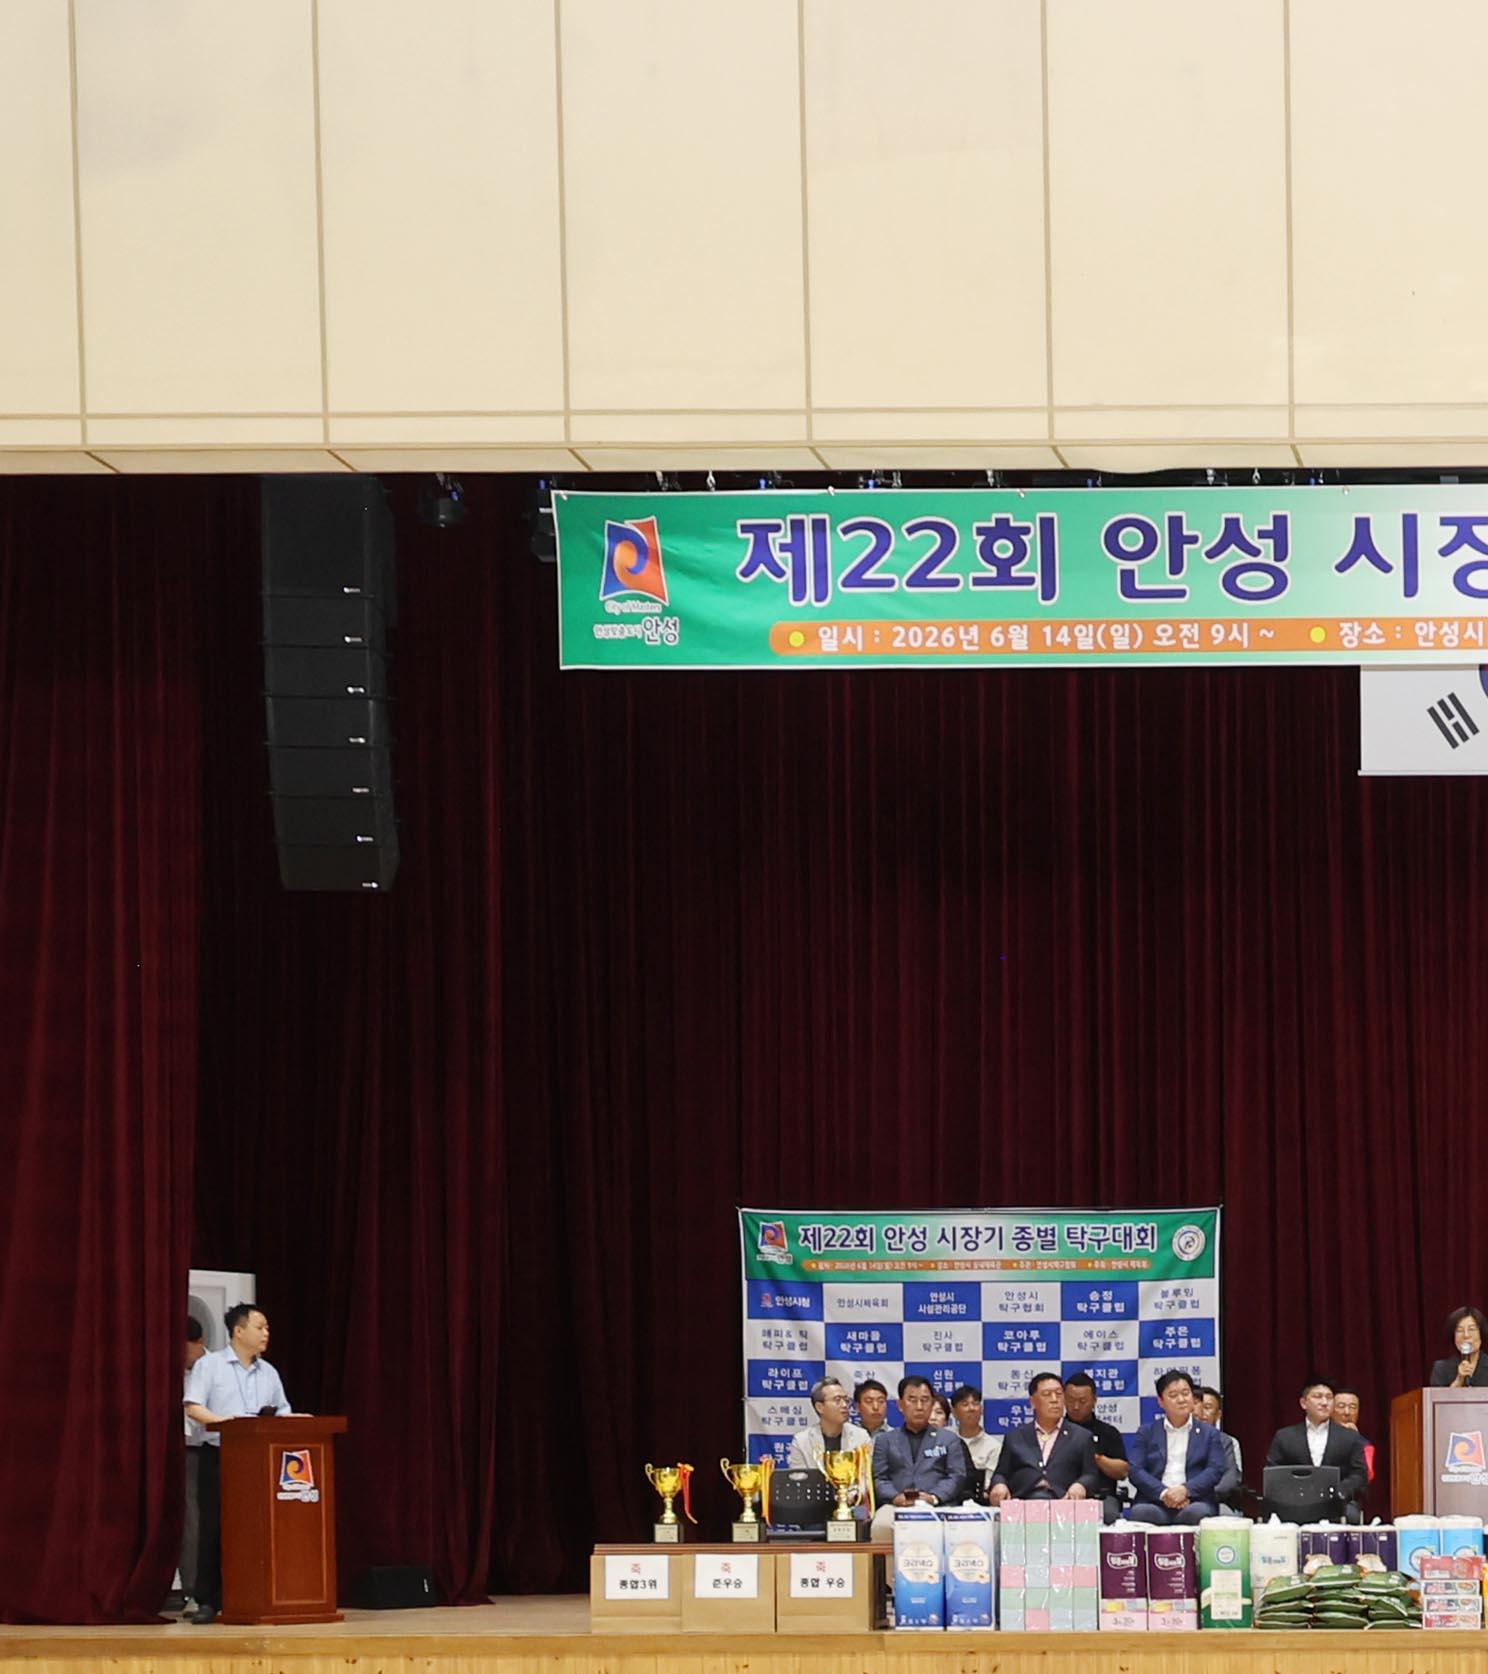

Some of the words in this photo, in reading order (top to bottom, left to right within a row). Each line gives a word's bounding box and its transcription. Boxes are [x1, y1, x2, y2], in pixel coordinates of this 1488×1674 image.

[737, 512, 1057, 604] 제22회
[1102, 511, 1291, 602] 안성
[643, 618, 679, 643] 안성
[818, 624, 863, 651] 일시
[892, 624, 980, 651] 2026년
[990, 623, 1030, 651] 6월
[1043, 622, 1142, 650] 14일(일)
[1153, 621, 1200, 649] 오전
[1211, 621, 1250, 648] 9시
[1339, 620, 1391, 647] 장소
[1415, 619, 1485, 646] 안성시
[799, 1225, 874, 1252] 제22회
[884, 1226, 928, 1251] 안성
[936, 1225, 1004, 1251] 시장기
[1011, 1224, 1057, 1251] 종별
[1065, 1224, 1157, 1251] 탁구대회
